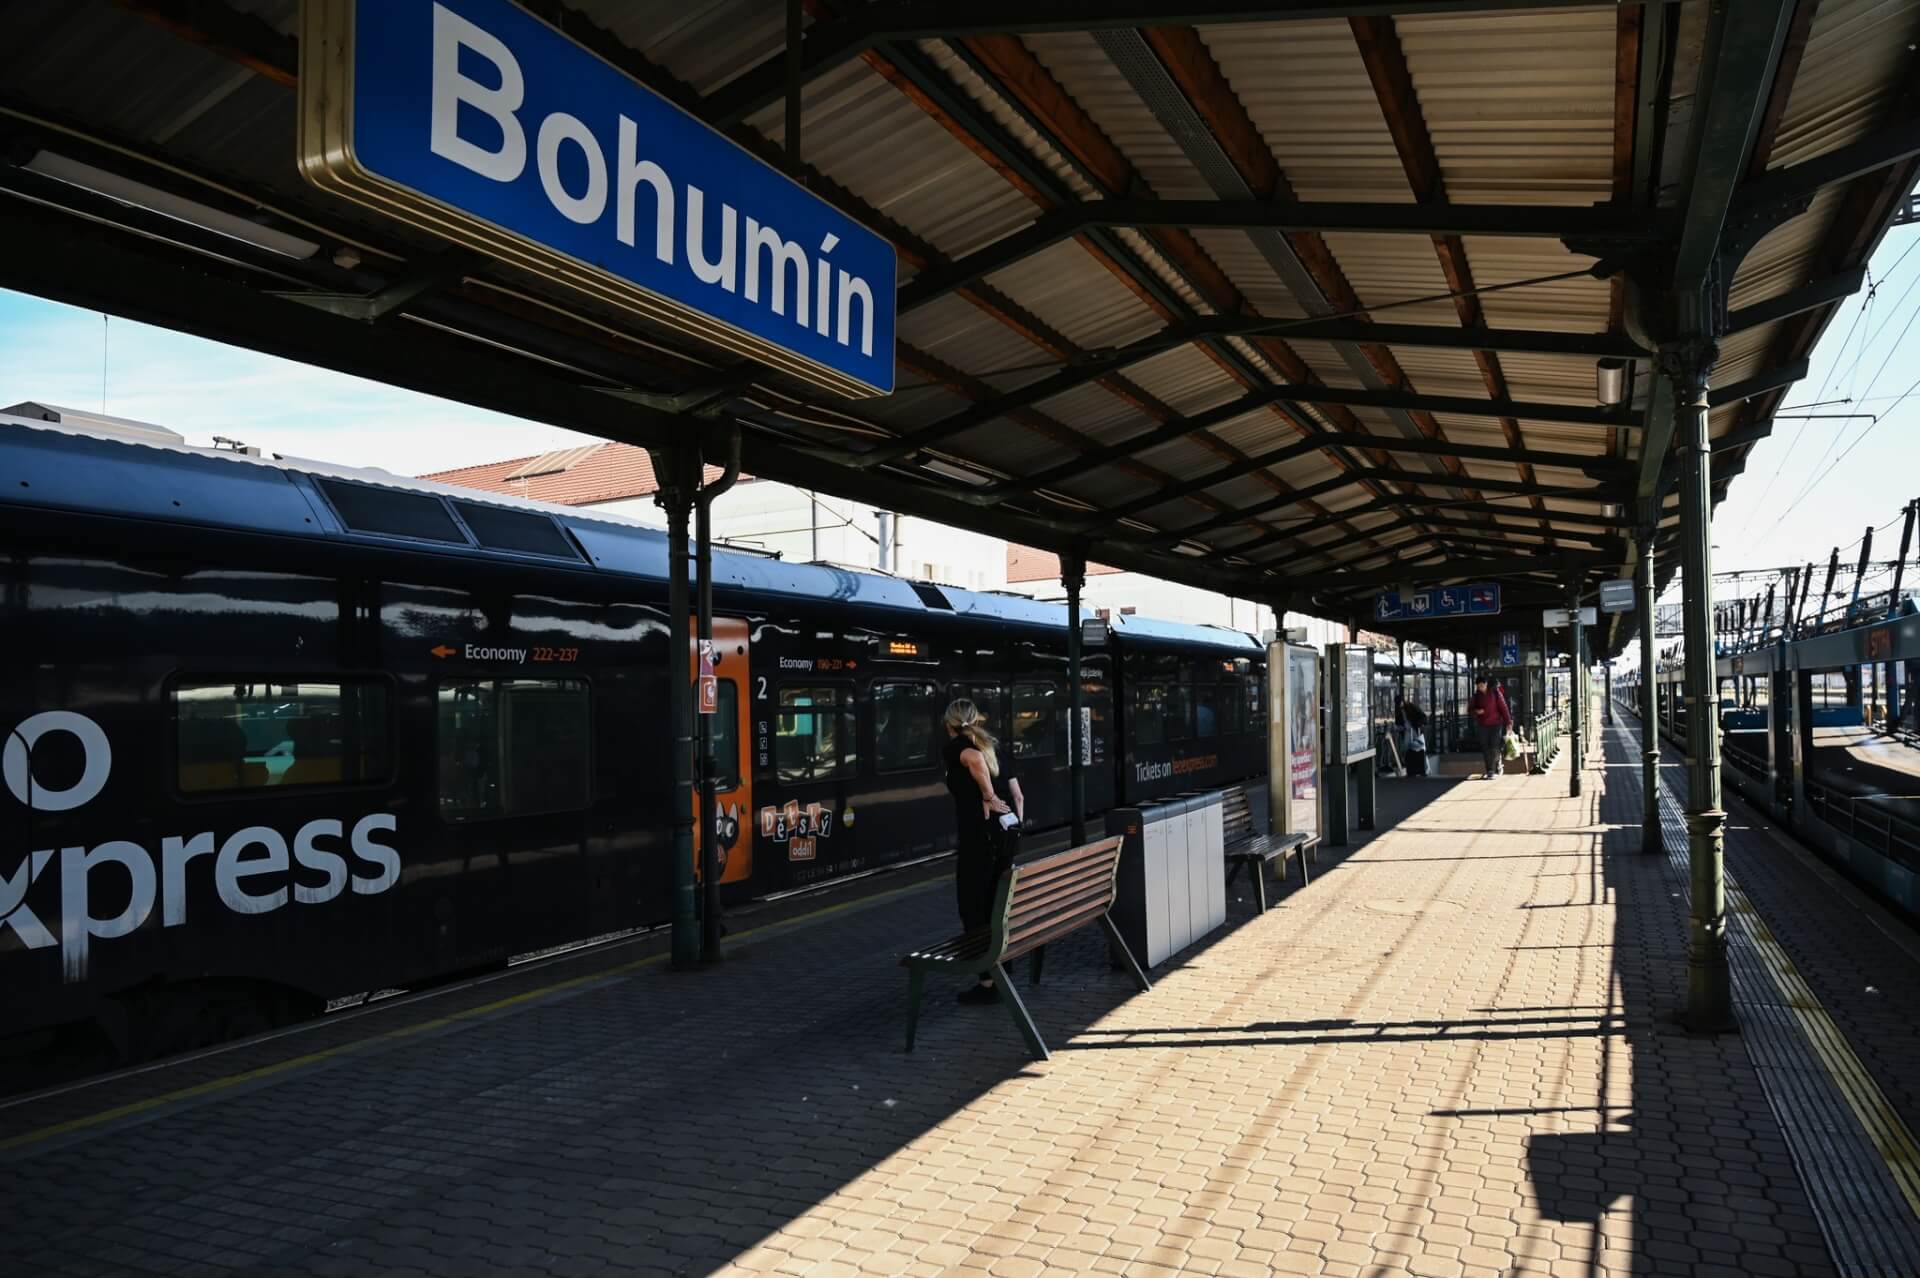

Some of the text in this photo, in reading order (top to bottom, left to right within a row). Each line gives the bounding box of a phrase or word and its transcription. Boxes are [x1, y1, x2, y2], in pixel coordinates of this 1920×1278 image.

[430, 1, 875, 358] Bohumín
[464, 643, 528, 665] Economy
[779, 656, 813, 672] Economy
[757, 676, 768, 700] 2
[1135, 761, 1161, 782] Tickets
[1161, 762, 1172, 777] on
[765, 803, 830, 838] Dětský
